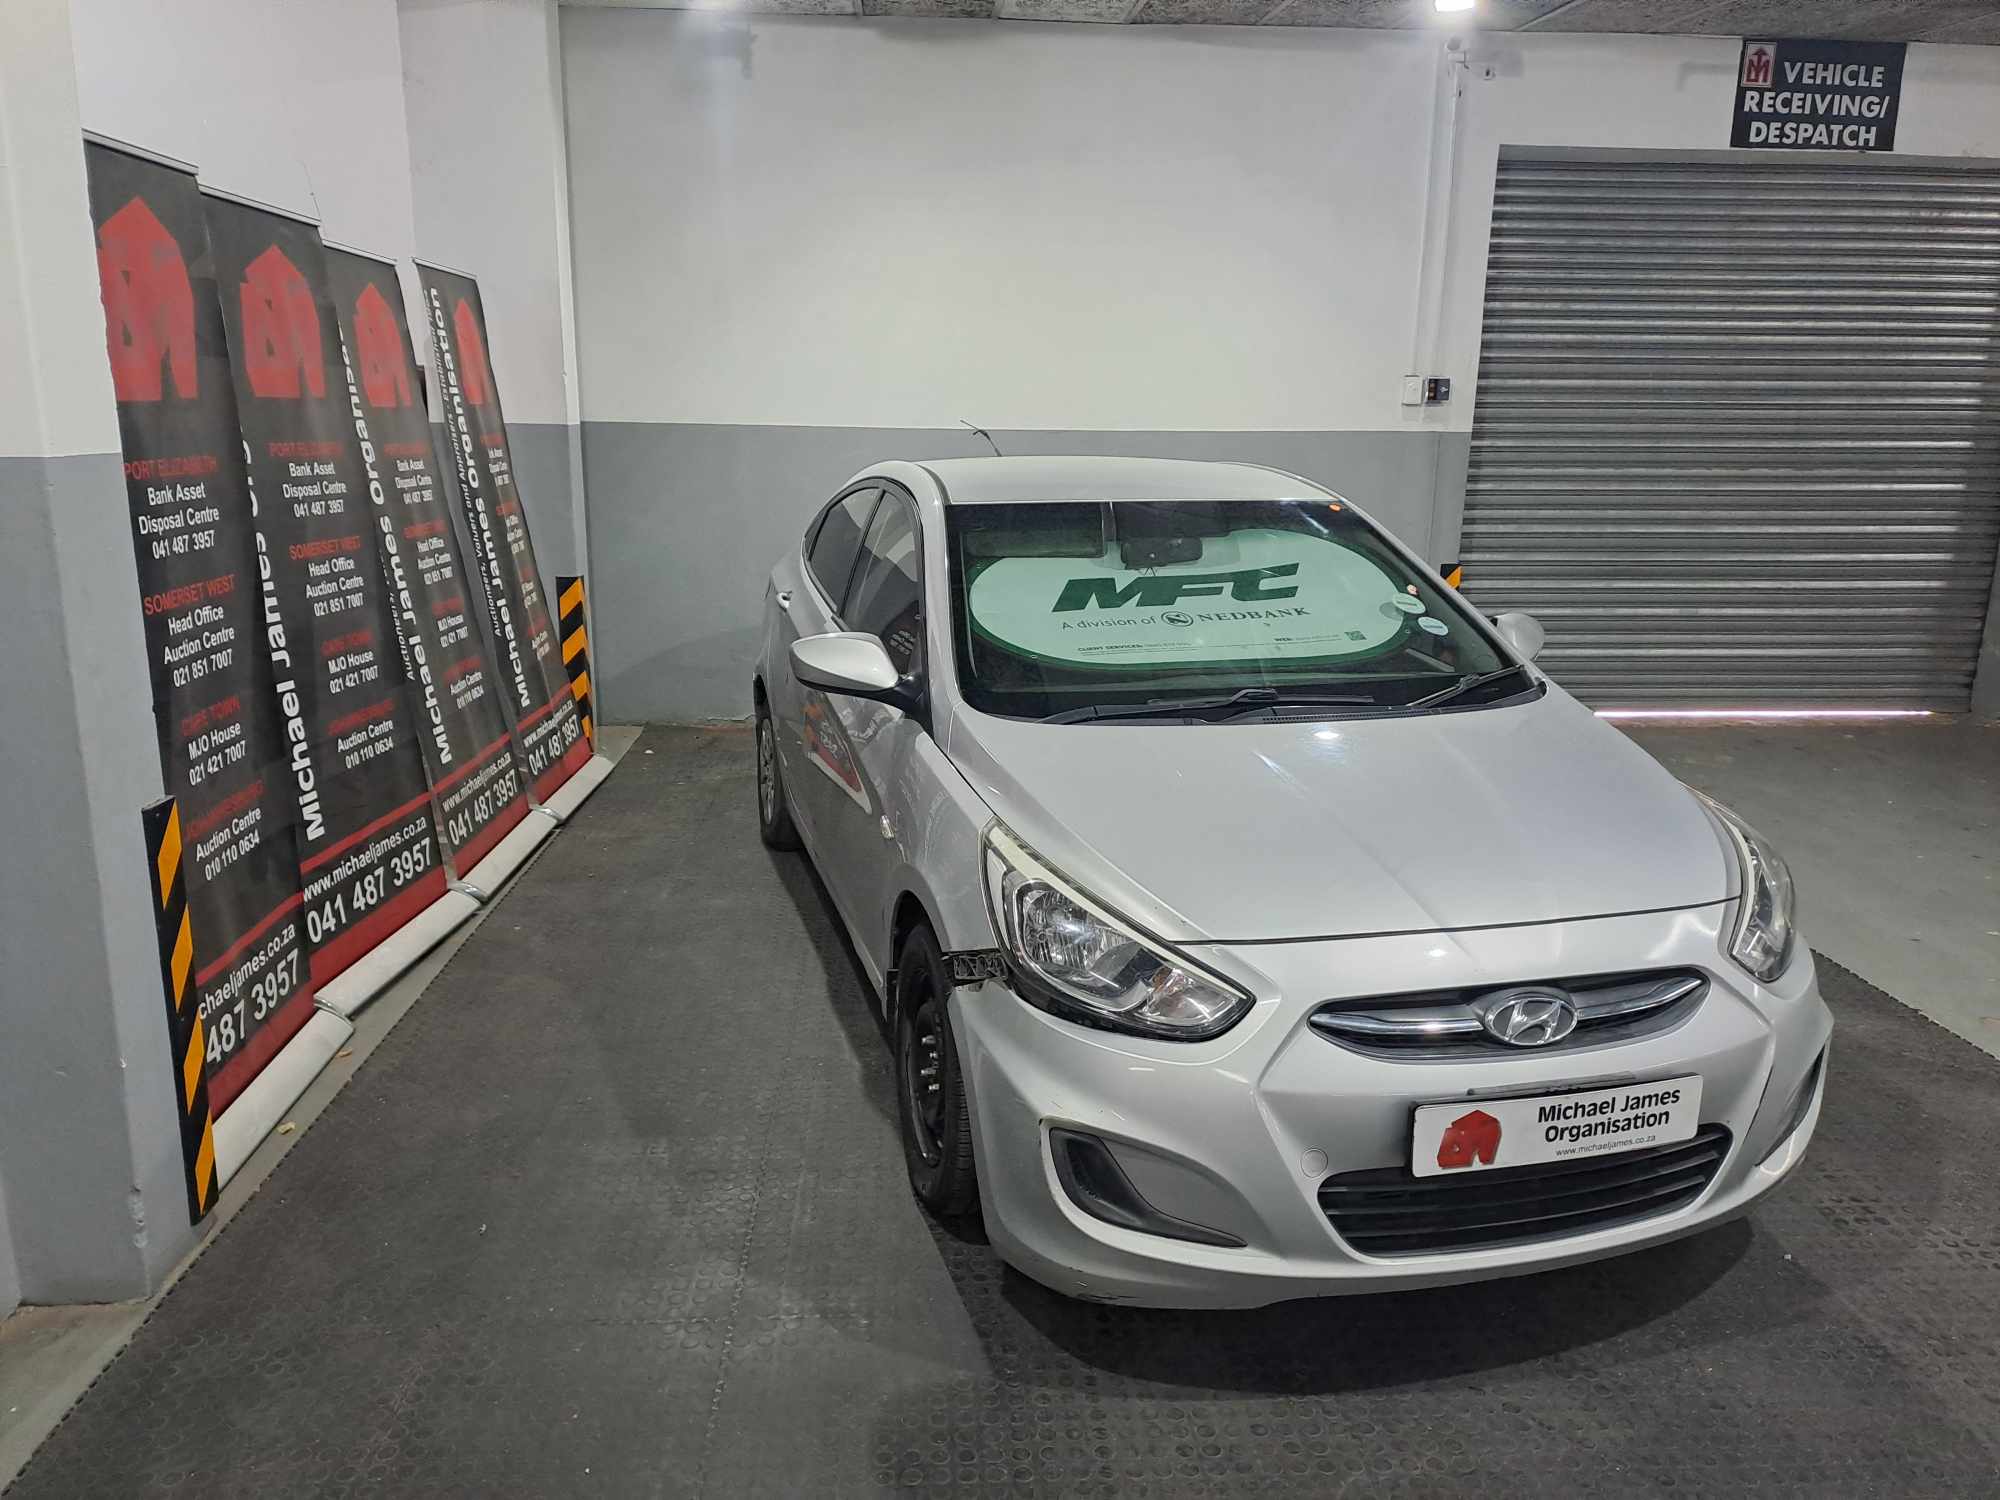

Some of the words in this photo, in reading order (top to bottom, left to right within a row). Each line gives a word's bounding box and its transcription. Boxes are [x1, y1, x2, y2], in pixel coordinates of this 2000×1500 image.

[1784, 62, 1885, 87] VEHICLE
[1743, 90, 1890, 118] RECEIVING/
[1749, 122, 1877, 147] DESPATCH
[430, 287, 479, 489] Organisation
[288, 462, 312, 477] Bank
[314, 461, 336, 476] Asset
[147, 485, 174, 506] Bank
[176, 482, 206, 502] Asset
[283, 483, 321, 500] Disposal
[322, 481, 347, 496] Centre
[138, 510, 185, 536] Disposal
[187, 506, 220, 526] Centre
[294, 502, 309, 518] 041
[311, 501, 326, 516] 487
[152, 540, 170, 560] 041
[172, 534, 189, 555] 487
[193, 529, 215, 551] 3957
[468, 510, 483, 558] Valuers
[475, 497, 503, 591] James
[308, 561, 330, 577] Head
[331, 557, 355, 573] Office
[380, 516, 417, 625] James
[306, 580, 338, 599] Auction
[339, 575, 365, 591] Centre
[1052, 562, 1300, 612] MFC
[168, 611, 192, 636] Head
[194, 605, 224, 626] Office
[314, 602, 329, 617] 021
[330, 597, 345, 613] 851
[1062, 621, 1074, 631] A
[1077, 615, 1137, 630] division
[1141, 615, 1158, 626] of
[1196, 607, 1312, 622] NEDBANK
[164, 636, 201, 665] Auction
[203, 626, 235, 649] Centre
[328, 657, 347, 674] MJO
[347, 651, 374, 667] House
[496, 598, 530, 708] Michael
[173, 665, 191, 688] 021
[192, 658, 209, 680] 851
[211, 648, 233, 671] 7007
[329, 678, 345, 694] 021
[345, 672, 360, 688] 421
[360, 665, 378, 681] 7007
[408, 635, 452, 765] Michael
[188, 734, 210, 762] MJO
[210, 722, 241, 748] House
[337, 732, 368, 753] Auction
[368, 719, 393, 737] Centre
[345, 752, 360, 769] 010
[375, 737, 394, 754] 0634
[528, 745, 548, 776] 041
[562, 714, 580, 746] 3957
[189, 765, 206, 786] 021
[207, 752, 224, 775] 421
[224, 740, 246, 765] 7007
[276, 680, 326, 842] Michael
[448, 808, 473, 846] 041
[474, 790, 496, 824] 487
[493, 768, 518, 807] 3957
[195, 827, 231, 862] Auction
[232, 807, 262, 835] Centre
[205, 855, 222, 881] 010
[221, 844, 238, 867] 110
[239, 829, 261, 855] 0634
[303, 816, 427, 902] www.michaeljames.co.za
[307, 893, 347, 943] 041
[353, 866, 385, 912] 487
[390, 836, 432, 887] 3957
[206, 999, 245, 1064] 487
[251, 948, 299, 1020] 3957
[1538, 1097, 1616, 1124] Michael
[1620, 1089, 1680, 1113] James
[1545, 1110, 1670, 1143] Organisation
[1555, 1135, 1656, 1156] www.michaeljames.co.za
